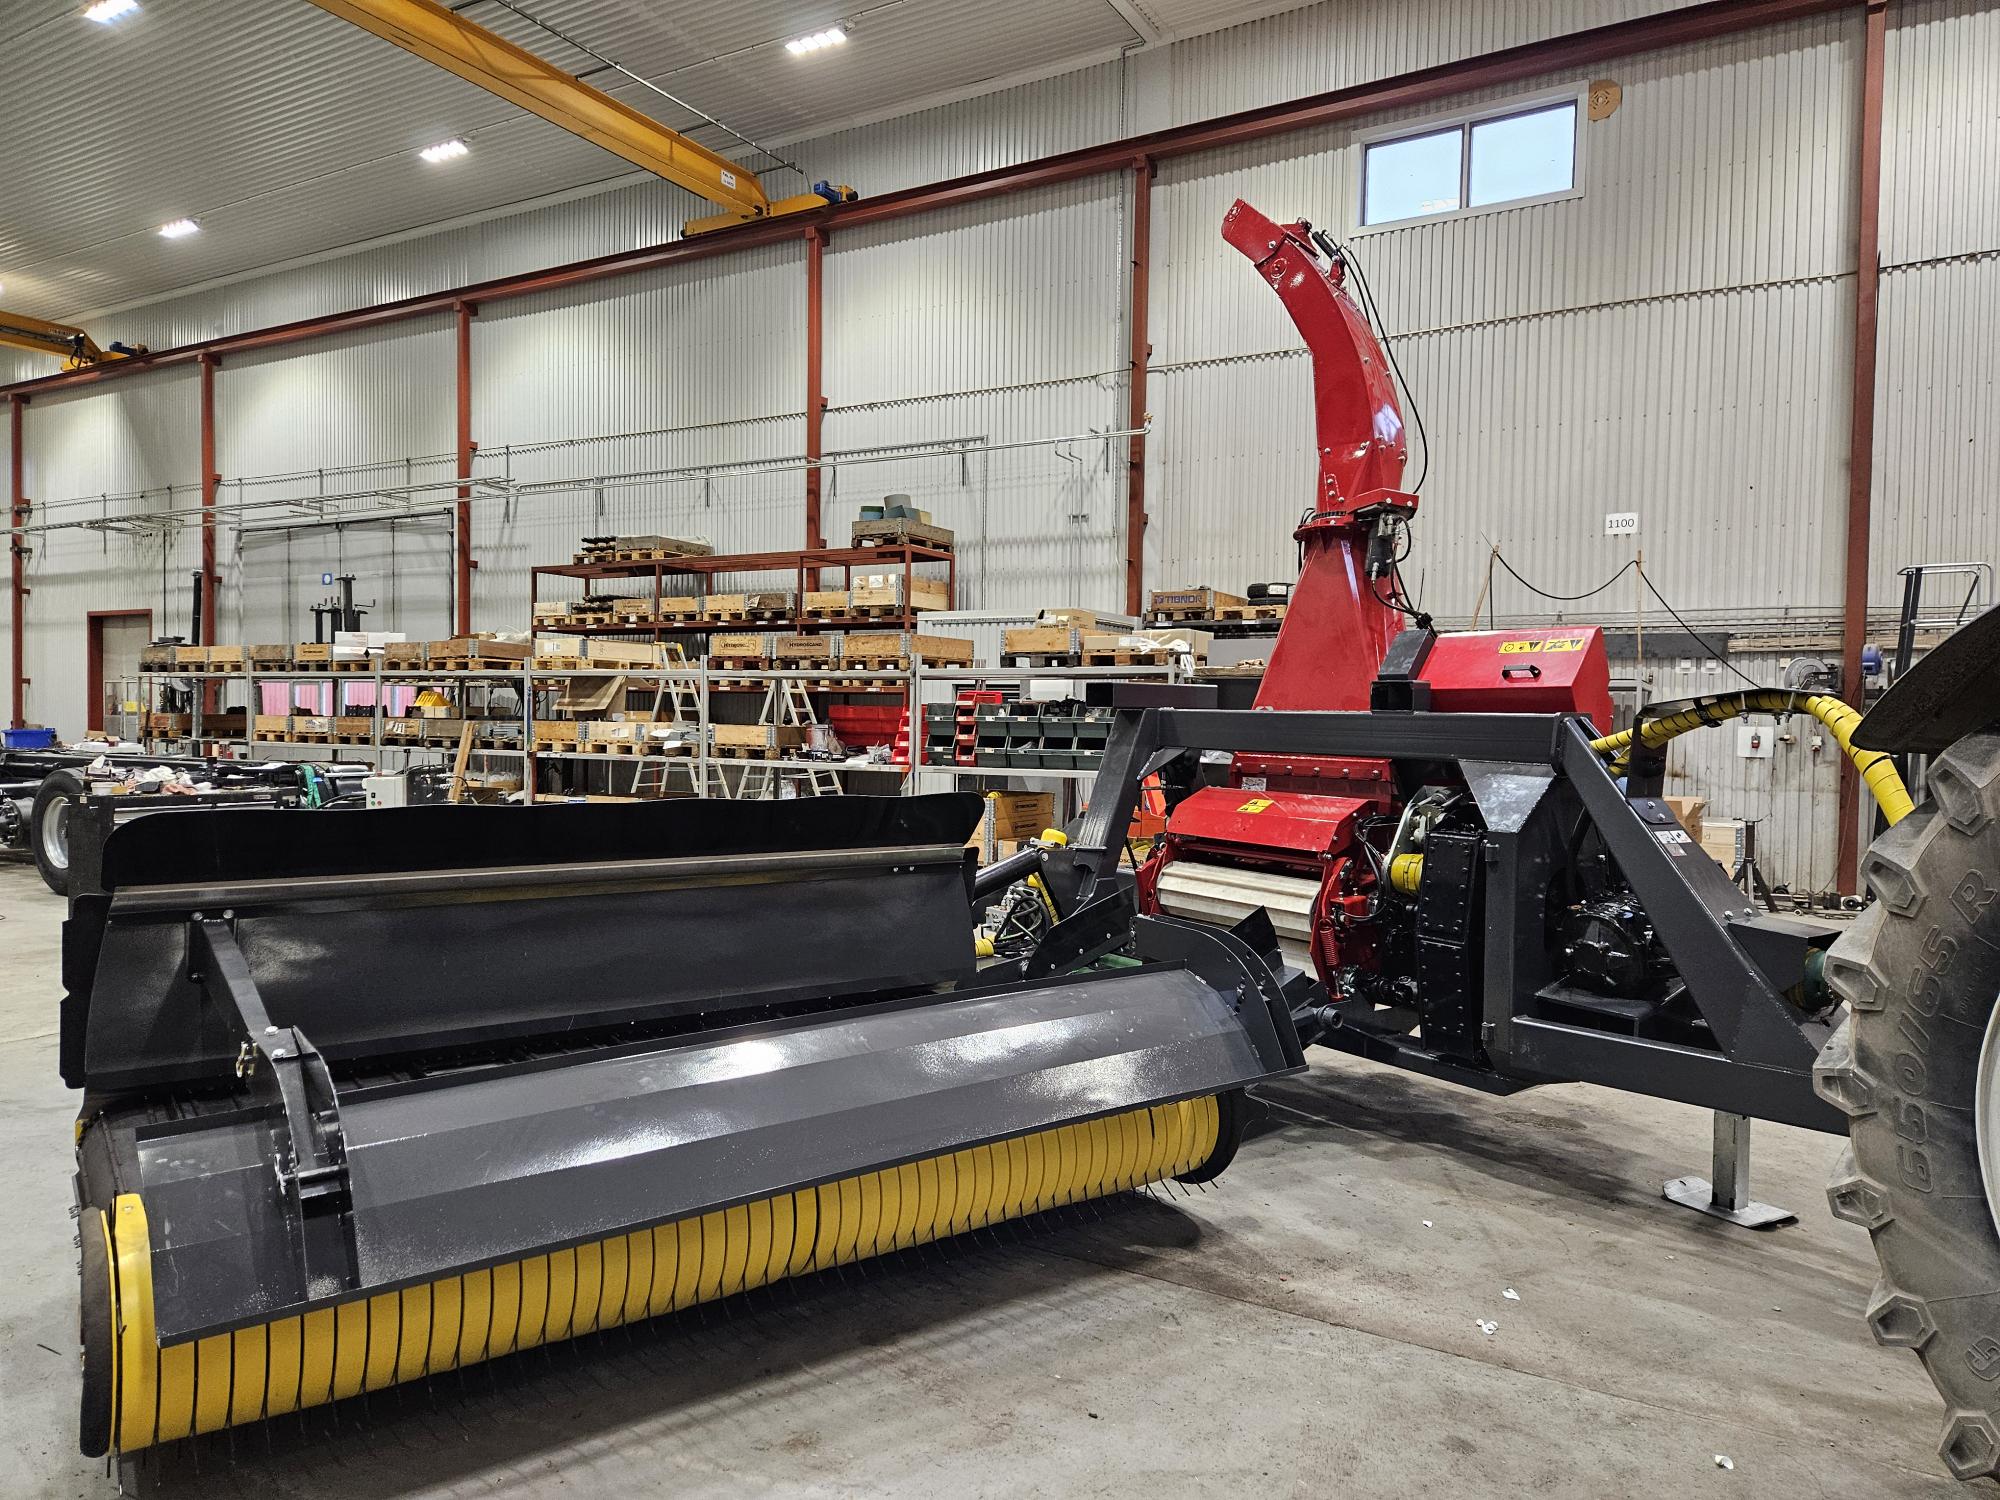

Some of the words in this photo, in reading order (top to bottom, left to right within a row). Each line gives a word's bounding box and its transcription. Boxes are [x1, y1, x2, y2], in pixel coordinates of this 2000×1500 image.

[1608, 518, 1635, 529] 1100
[1164, 594, 1202, 604] TIBNOR
[1894, 924, 1959, 1193] 650/65
